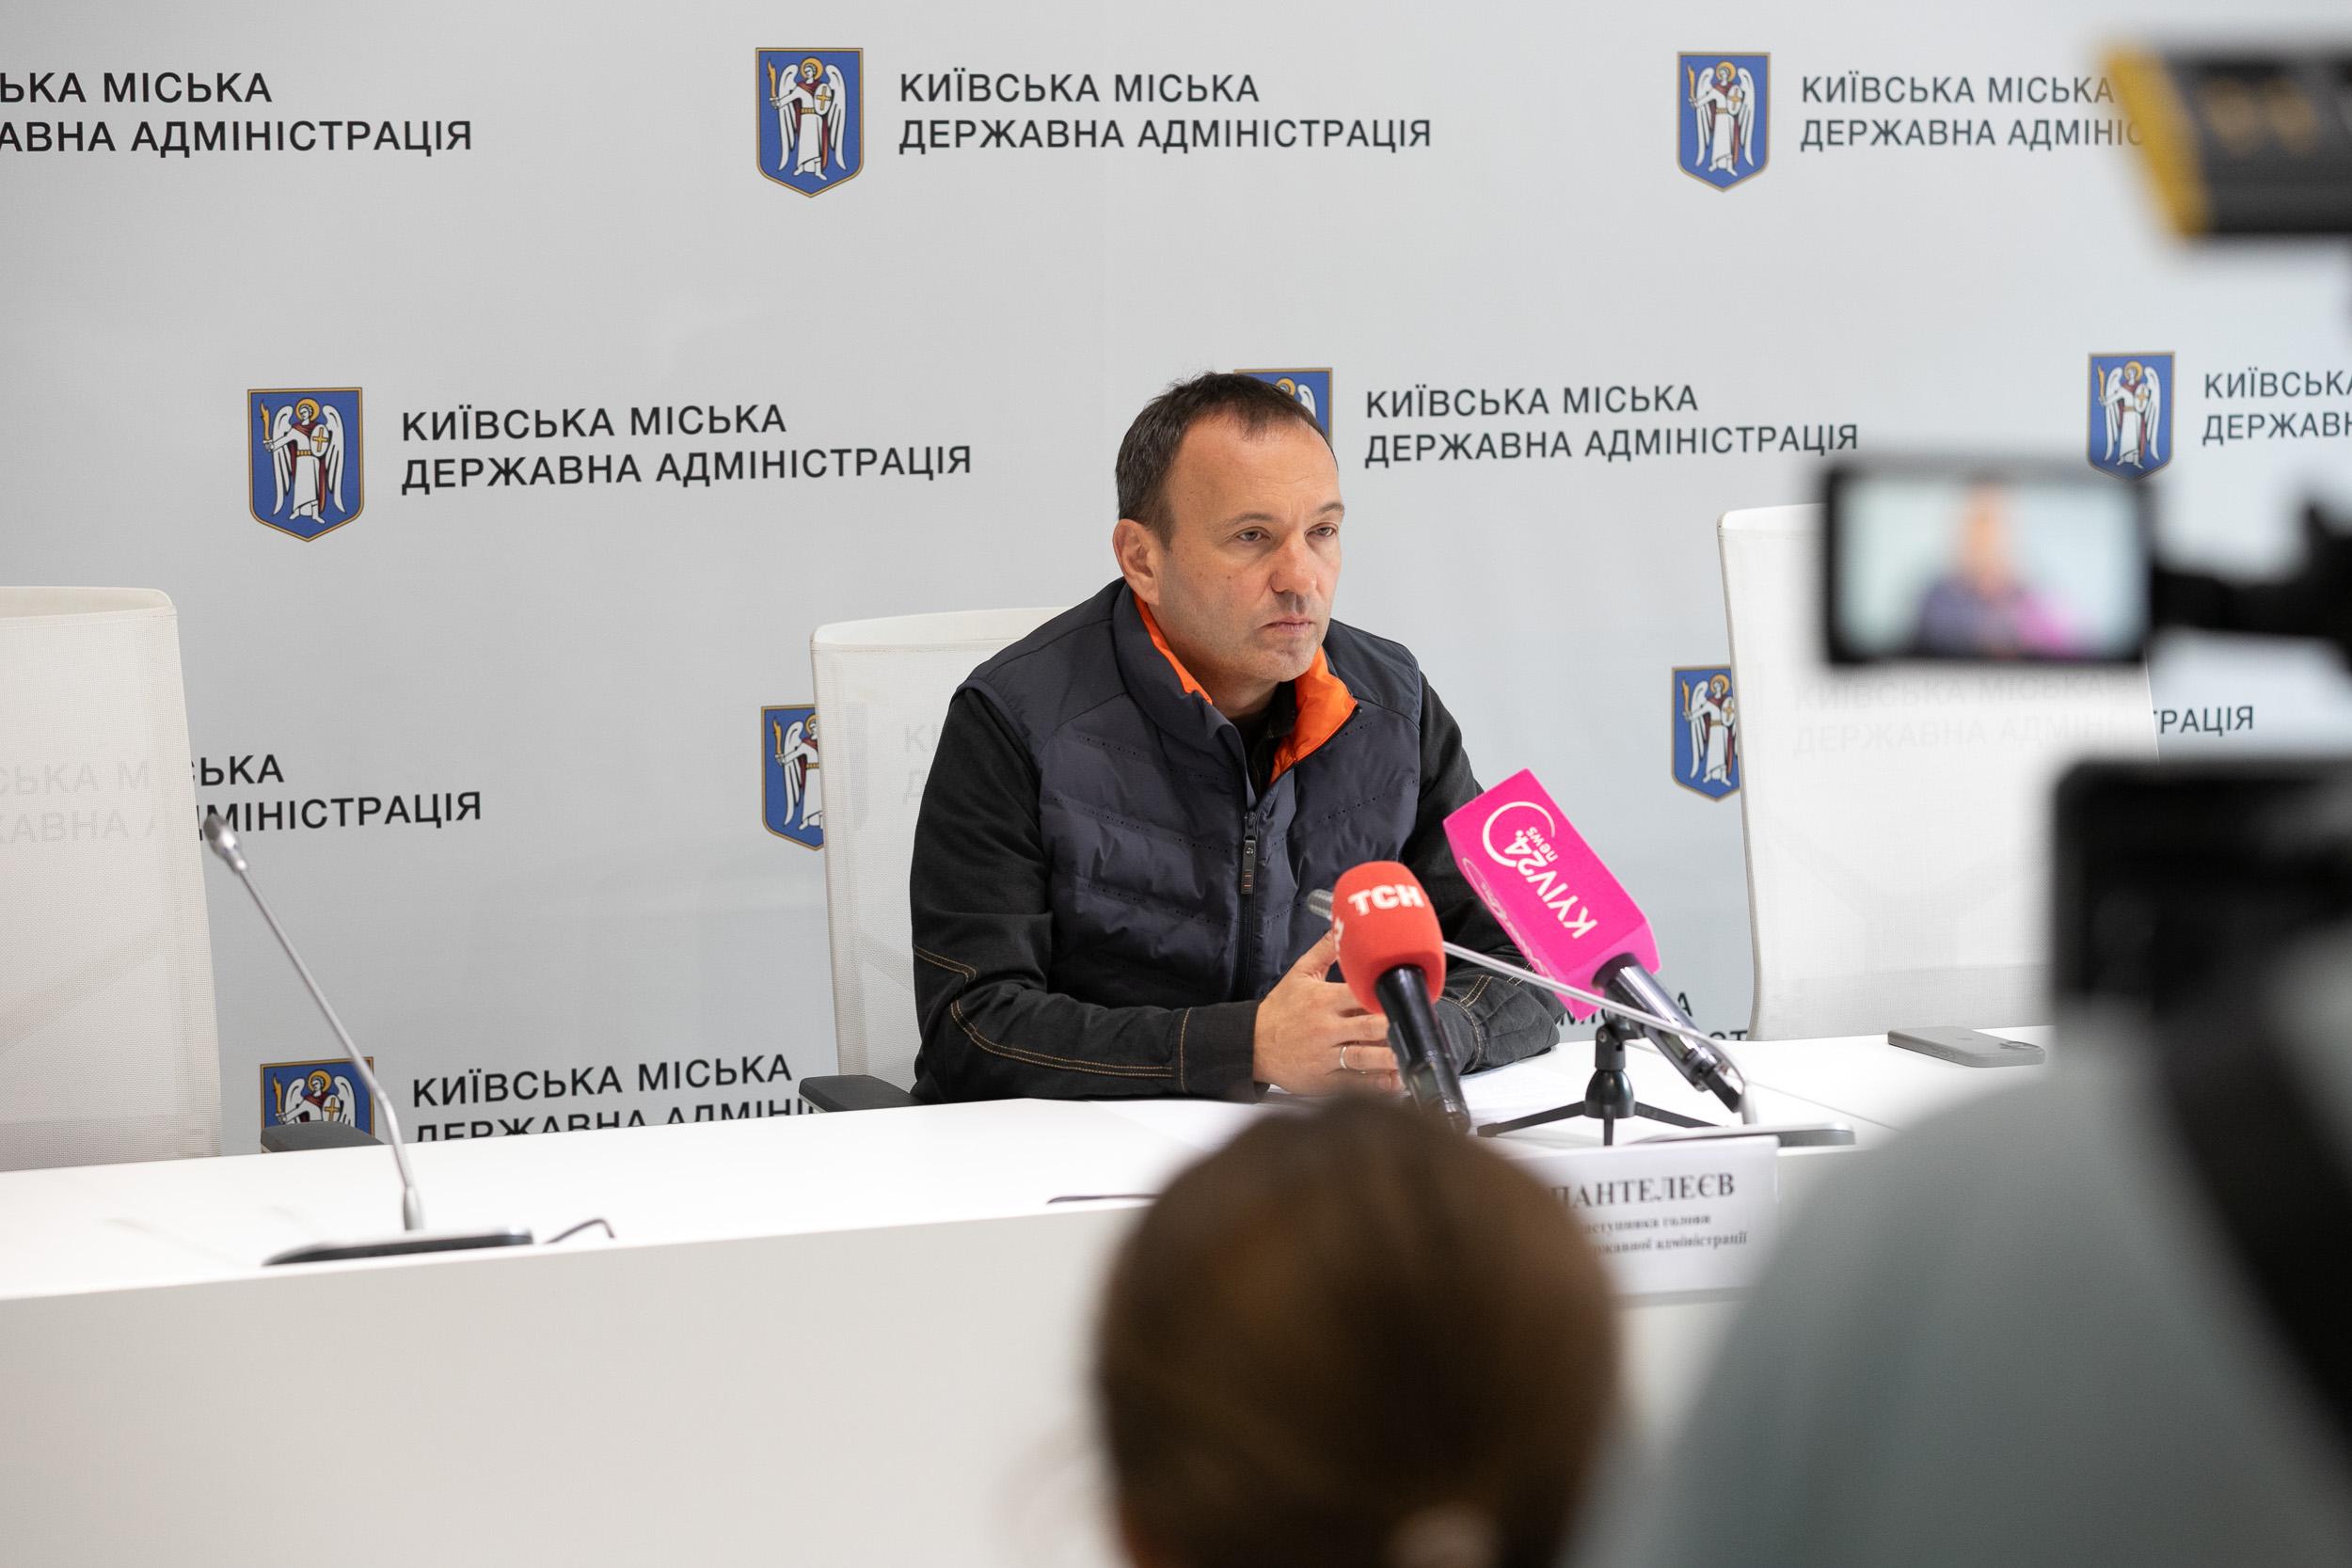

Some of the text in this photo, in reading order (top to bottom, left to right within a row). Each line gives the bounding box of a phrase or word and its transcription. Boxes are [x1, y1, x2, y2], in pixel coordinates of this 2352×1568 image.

[103, 71, 273, 103] МІСЬКА
[899, 67, 1260, 103] КИЇВСЬКА МІСЬКА
[1802, 71, 2115, 103] КИЇВСЬКА МІСЬКА
[130, 120, 472, 158] АДМІНІСТРАЦІЯ
[899, 119, 1431, 154] ДЕРЖАВНА АДМІНІСТРАЦІЯ
[1800, 119, 1995, 152] ДЕРЖАВНА
[1367, 381, 1698, 419] КИЇВСЬКА МІСЬКА
[2204, 366, 2352, 399] КИЇВСЬК
[402, 404, 787, 441] КИЇВСЬКА МІСЬКА
[1365, 424, 1858, 469] ДЕРЖАВНА АДМІНІСТРАЦІЯ
[401, 445, 971, 496] ДЕРЖАВНА АДМІНІСТРАЦІЯ
[1526, 827, 1558, 863] news
[1347, 884, 1425, 916] ТСН
[413, 1053, 792, 1108] КИЇВСЬКА МІСЬКА
